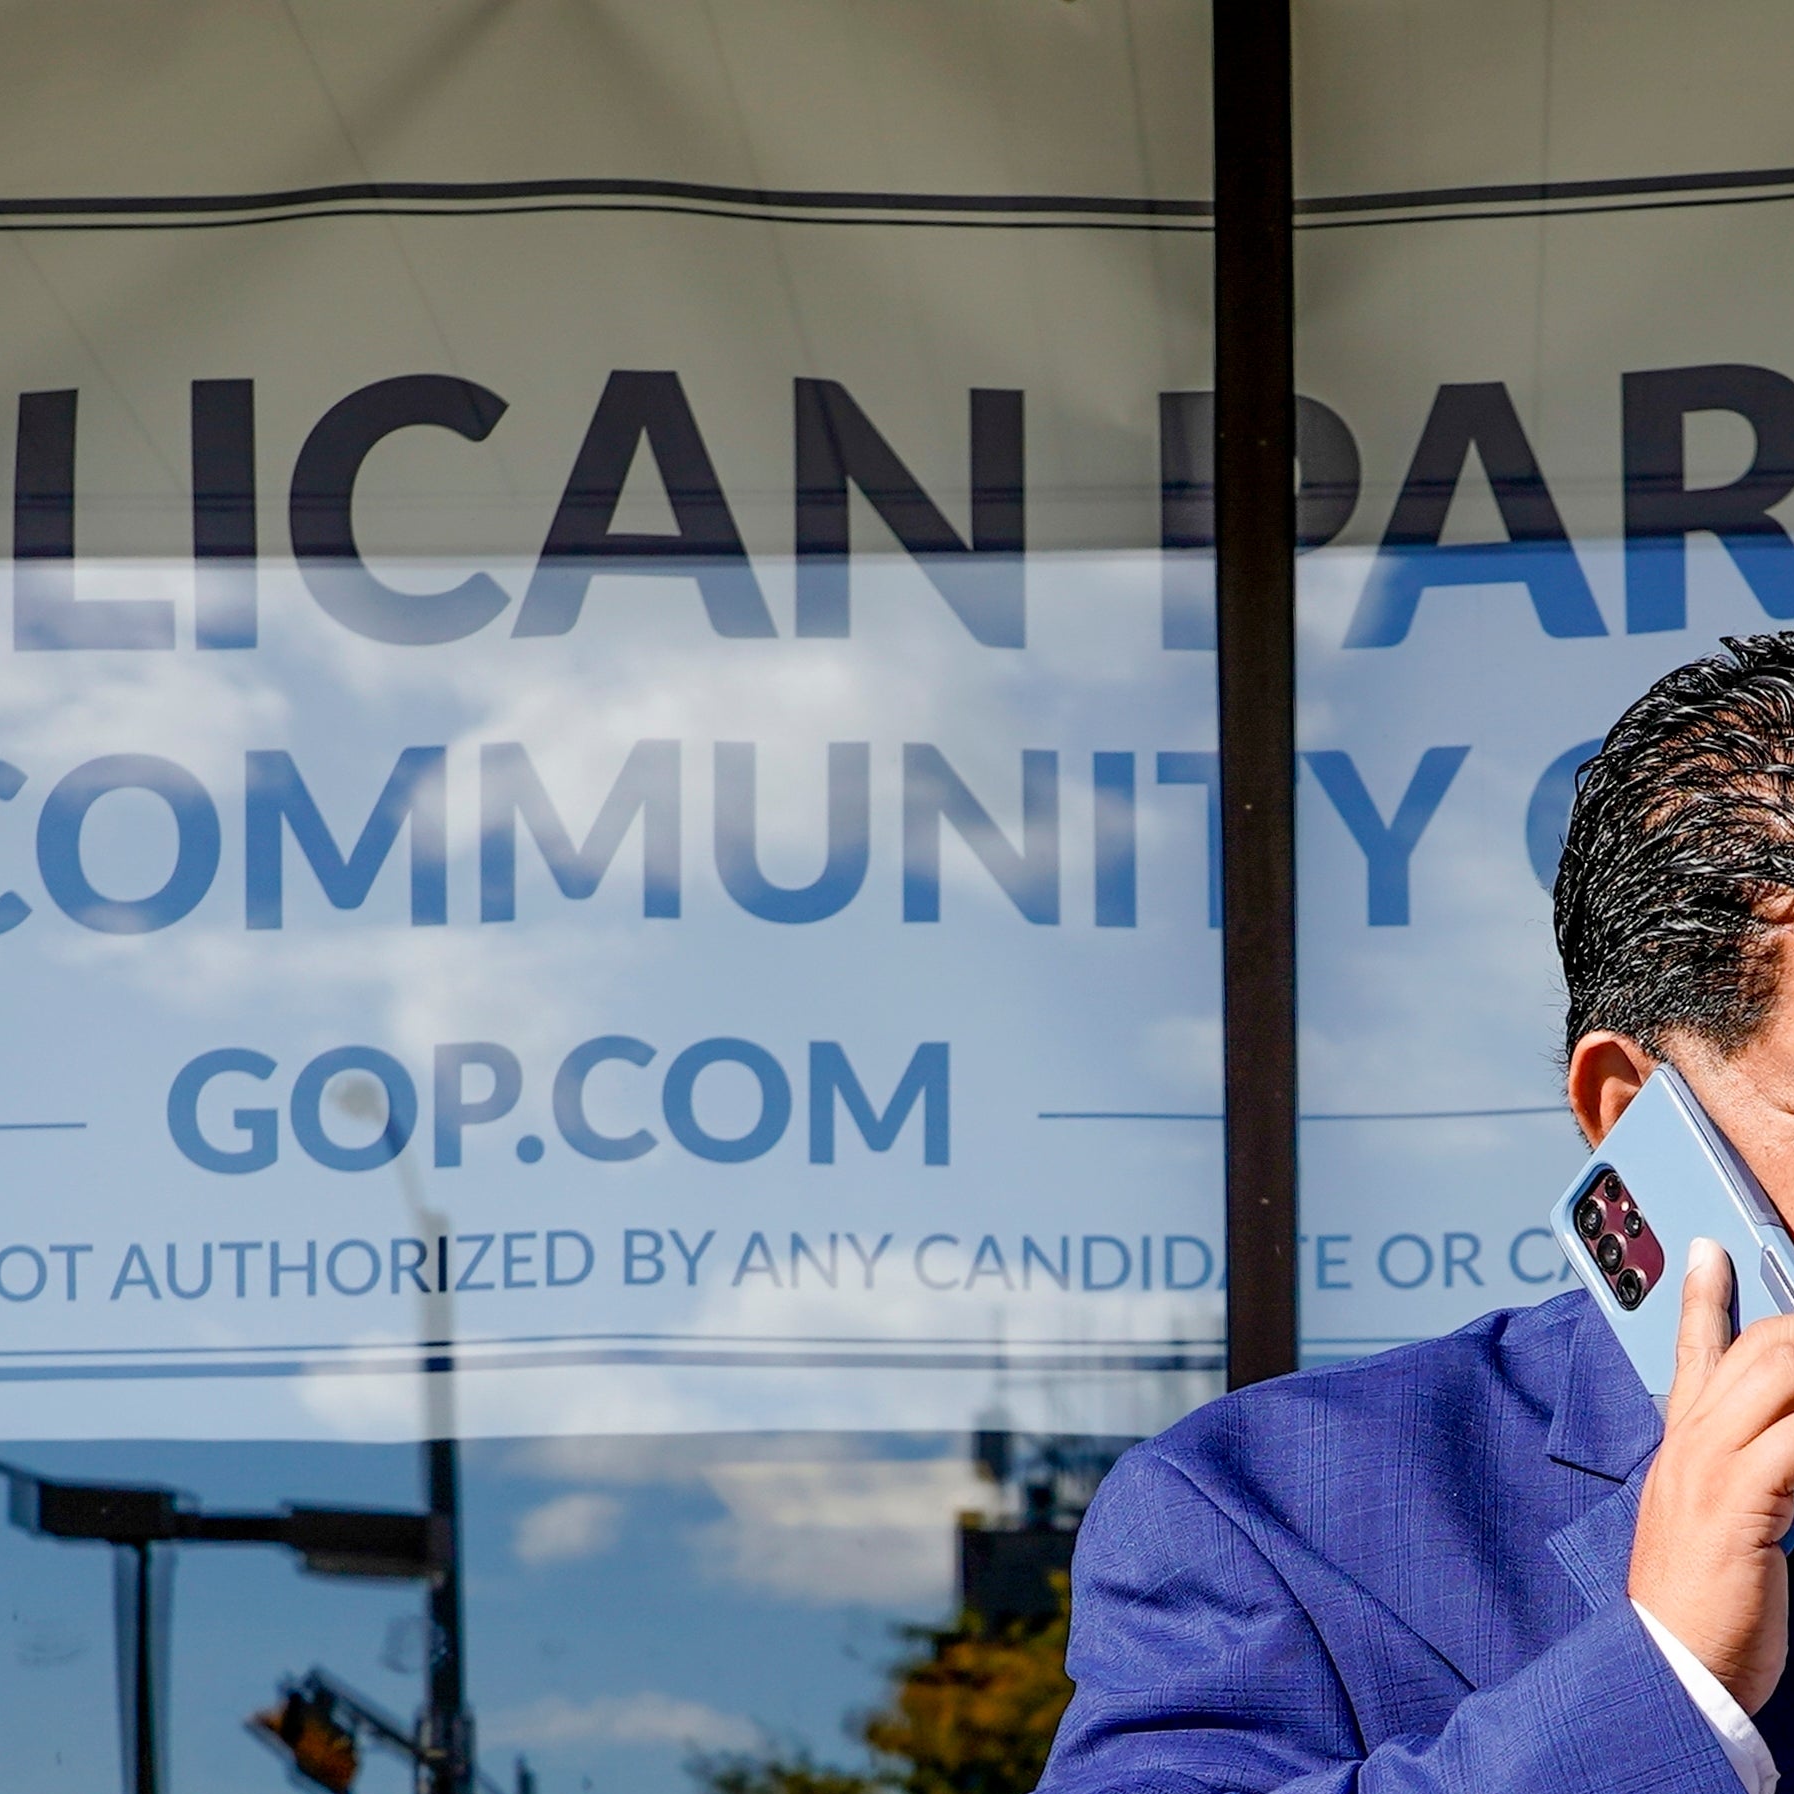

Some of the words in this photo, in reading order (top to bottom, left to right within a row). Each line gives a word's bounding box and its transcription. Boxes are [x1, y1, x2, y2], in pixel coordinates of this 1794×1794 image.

[167, 1036, 951, 1174] GOP.COM
[109, 1228, 596, 1302] AUTHORIZED
[622, 1227, 717, 1287] BY
[730, 1230, 895, 1291] ANY
[913, 1232, 1355, 1292] CANDIDE
[1376, 1230, 1487, 1290] OR
